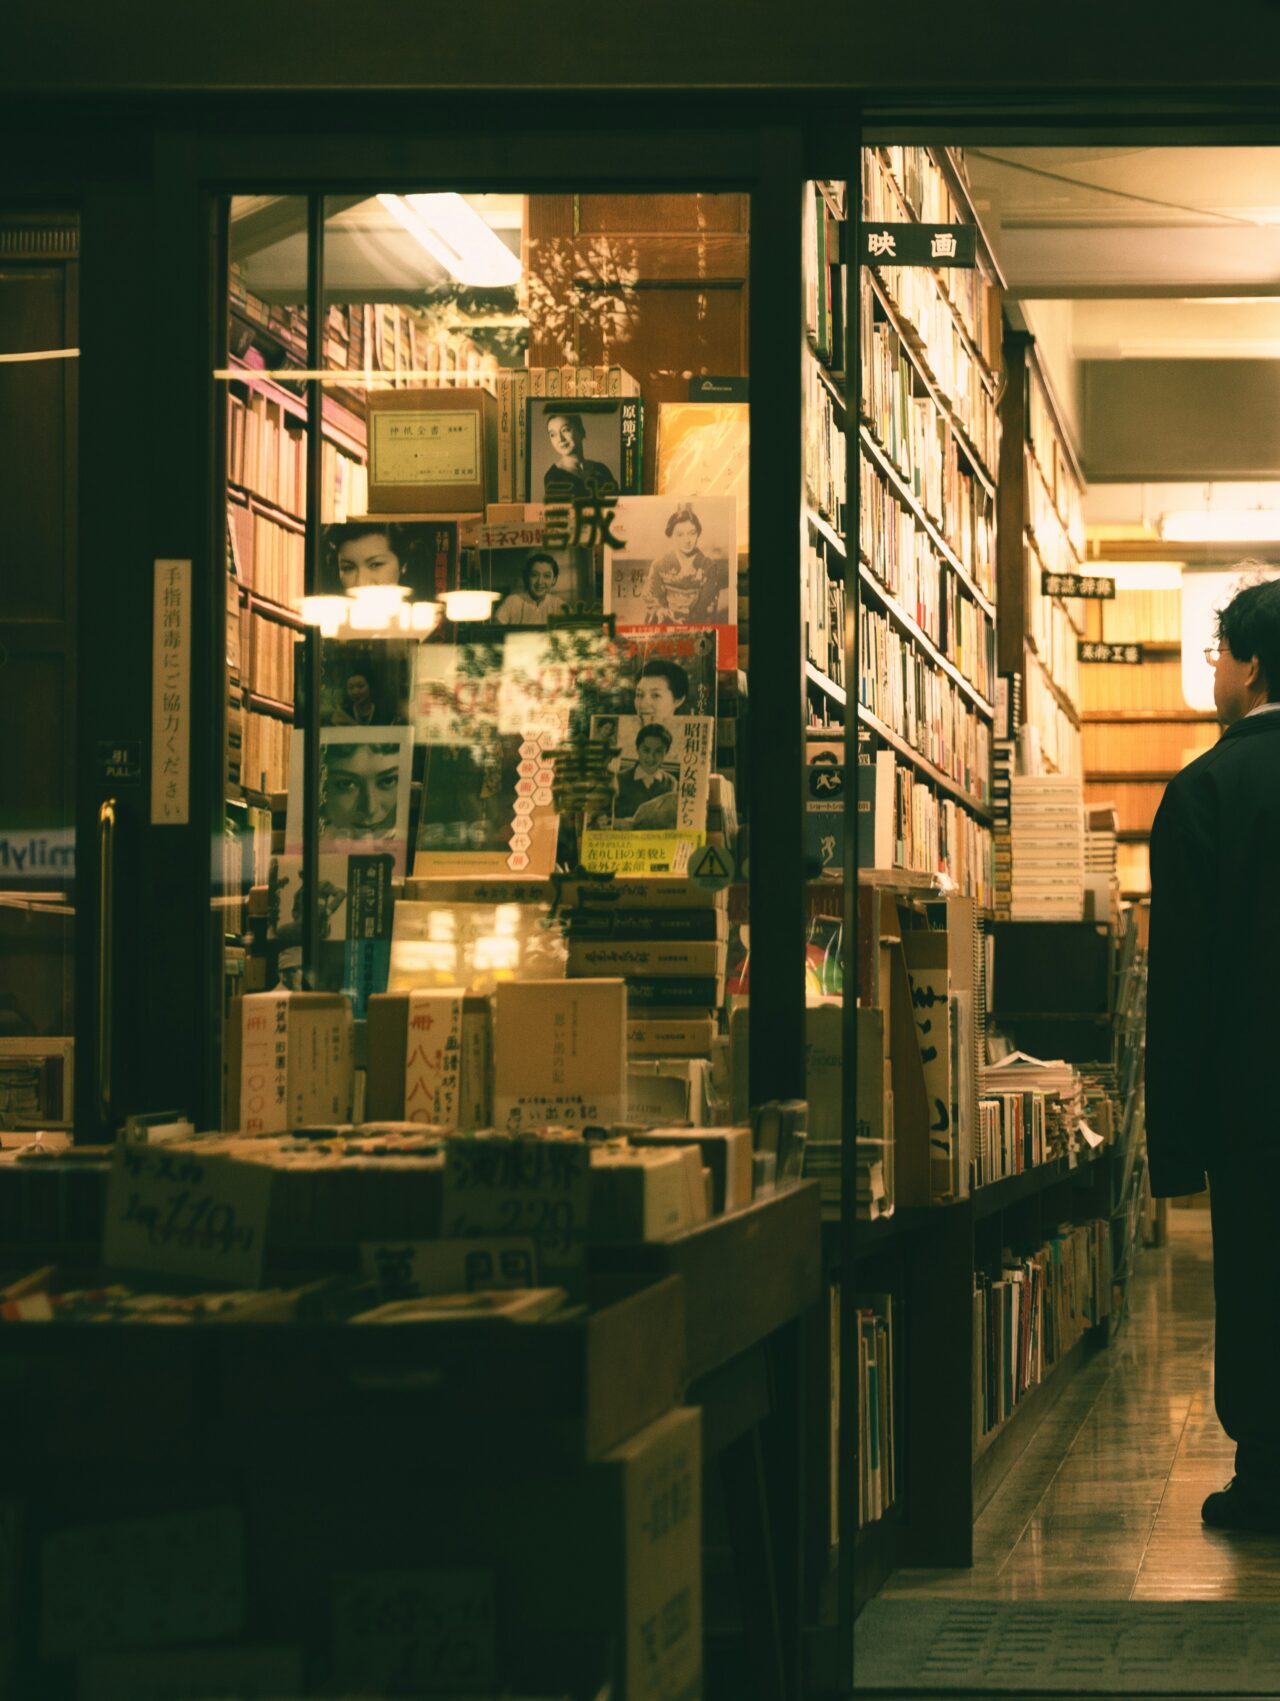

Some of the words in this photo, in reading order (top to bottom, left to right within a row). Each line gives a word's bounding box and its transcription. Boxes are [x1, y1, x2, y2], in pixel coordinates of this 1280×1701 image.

[868, 231, 957, 257] 映画
[622, 405, 636, 447] 原節子
[162, 565, 182, 818] 手指消毒にご協力ください
[680, 722, 701, 827] 昭和の女優たち
[588, 848, 666, 860] 在りし日の美貌と
[509, 1106, 597, 1120] 思い出の記
